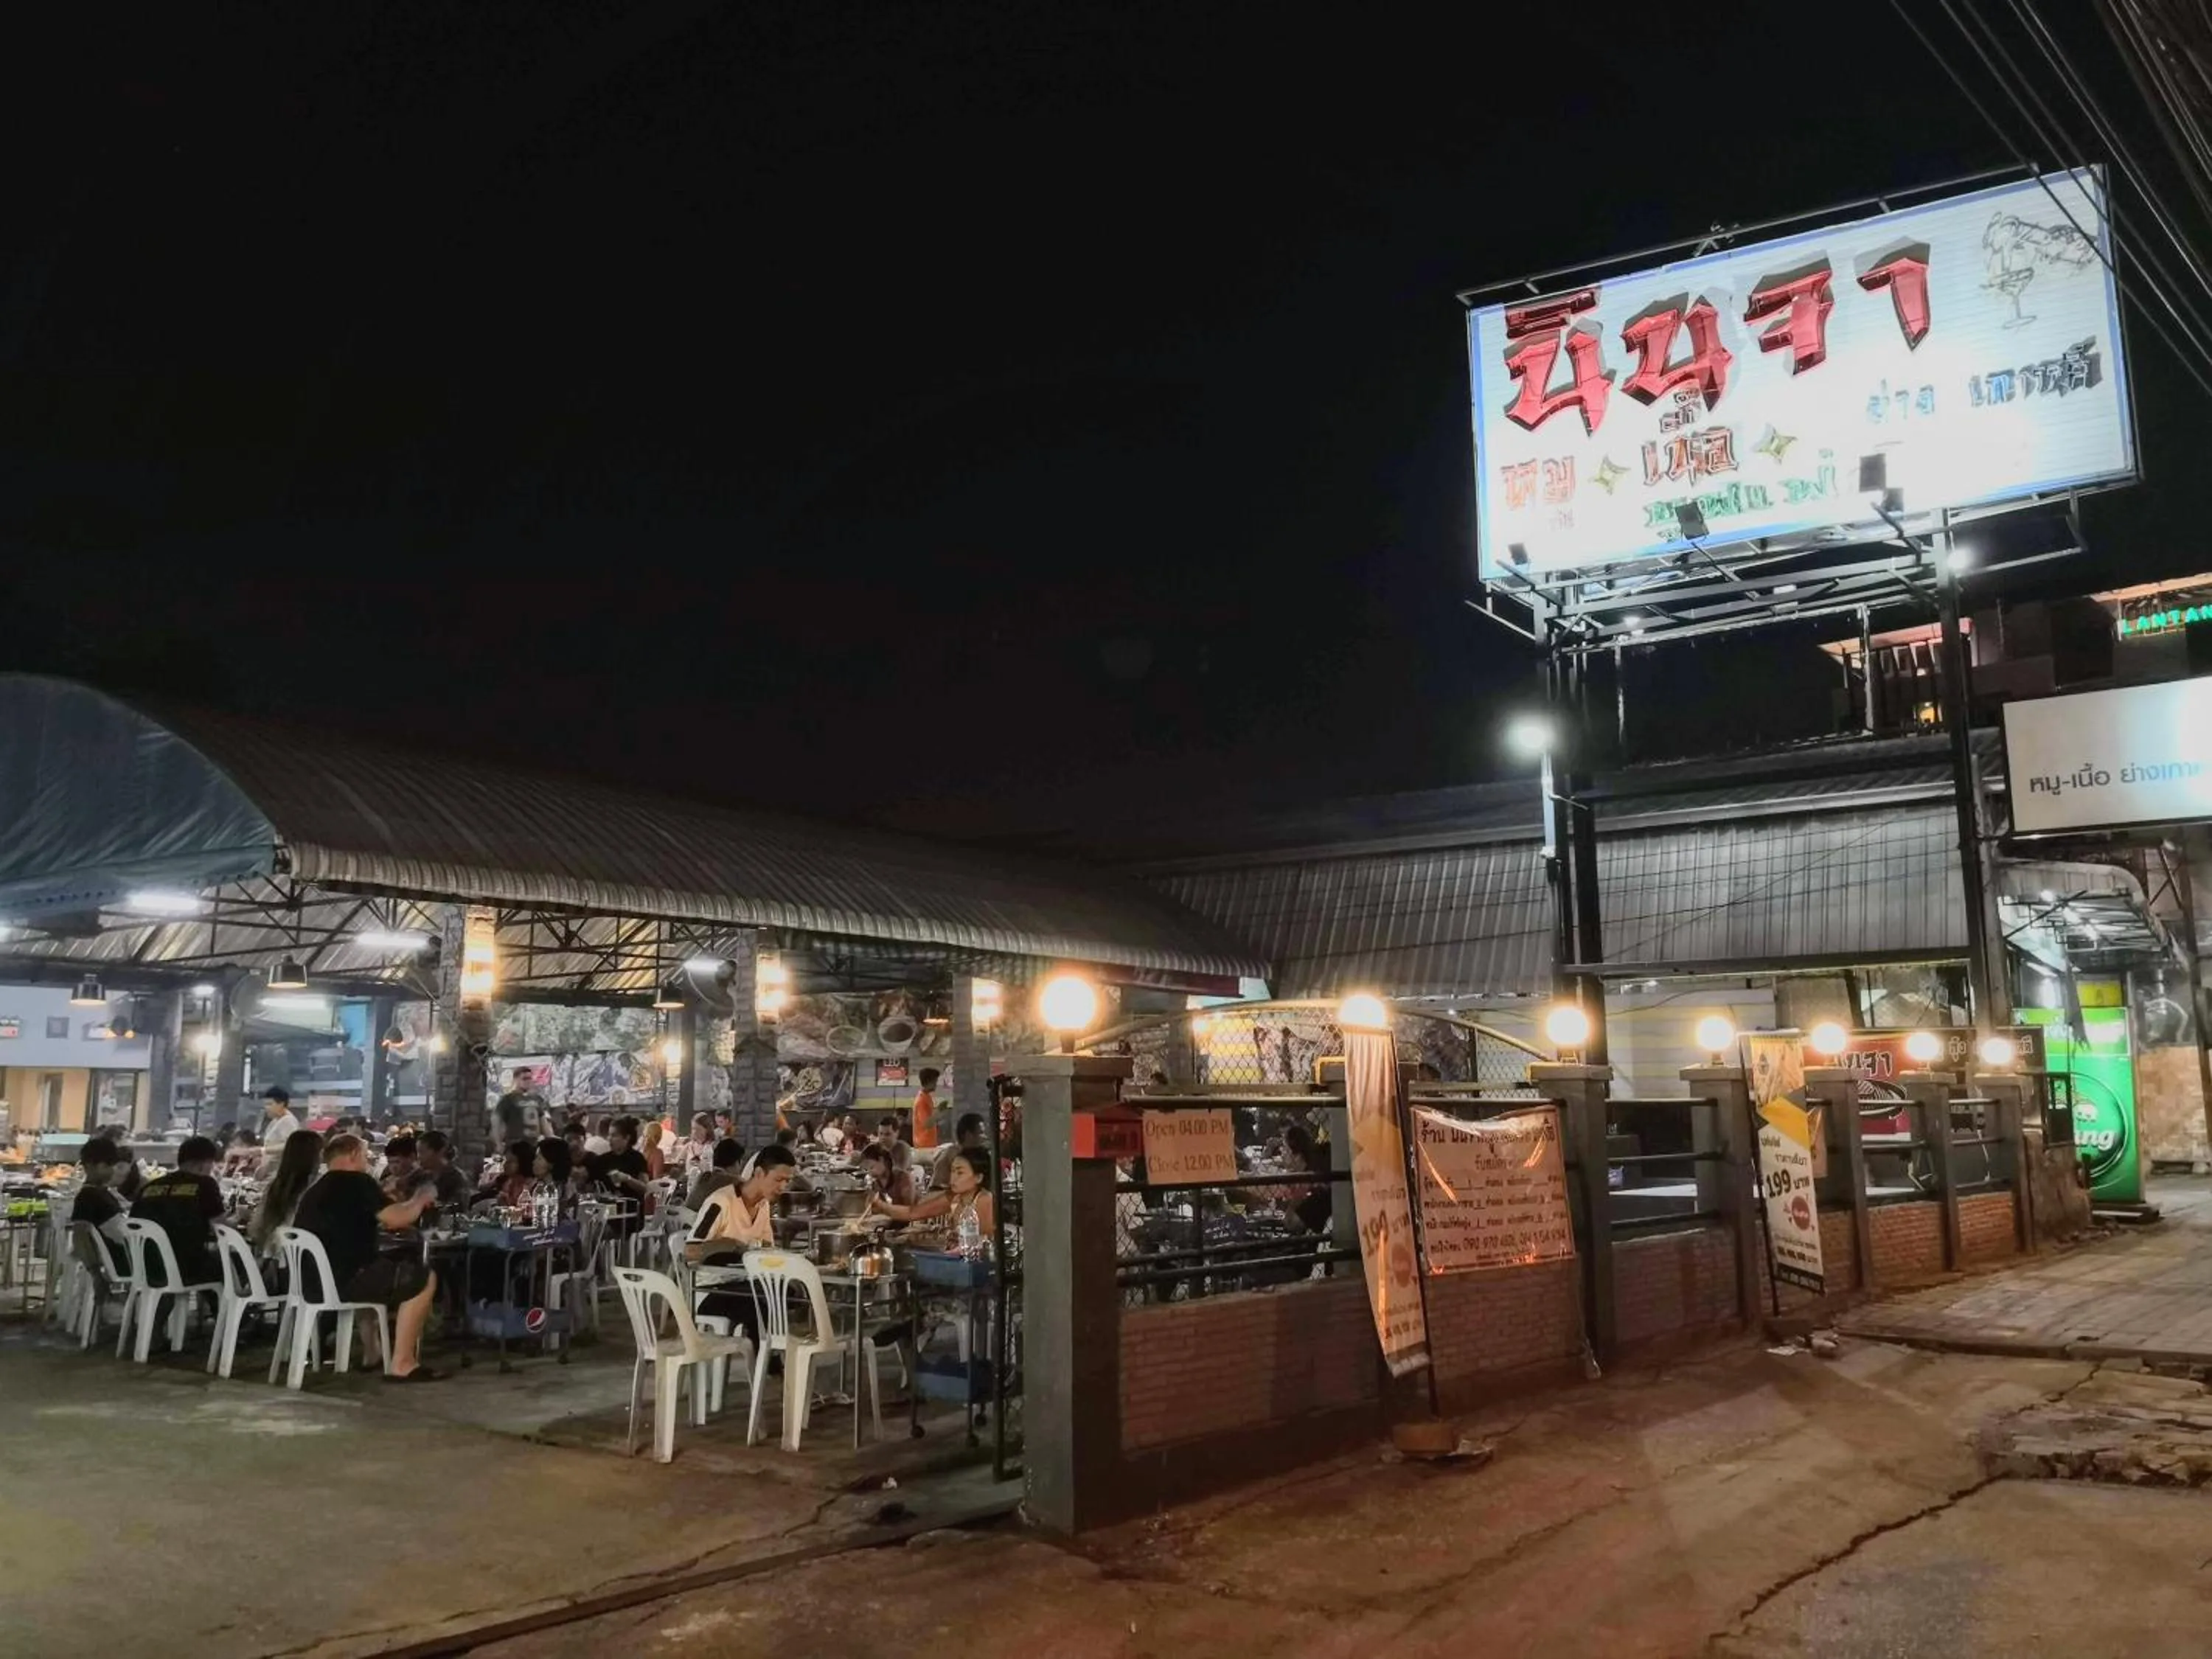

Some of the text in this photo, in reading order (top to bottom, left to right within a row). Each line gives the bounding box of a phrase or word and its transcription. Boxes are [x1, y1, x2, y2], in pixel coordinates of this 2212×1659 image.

[2030, 762, 2110, 796] หมู-เนื้อ
[1145, 1119, 1176, 1140] Open
[1211, 1118, 1229, 1135] PM
[1148, 1154, 1180, 1173] Close
[1215, 1152, 1234, 1171] PM
[1766, 1168, 1791, 1198] 199
